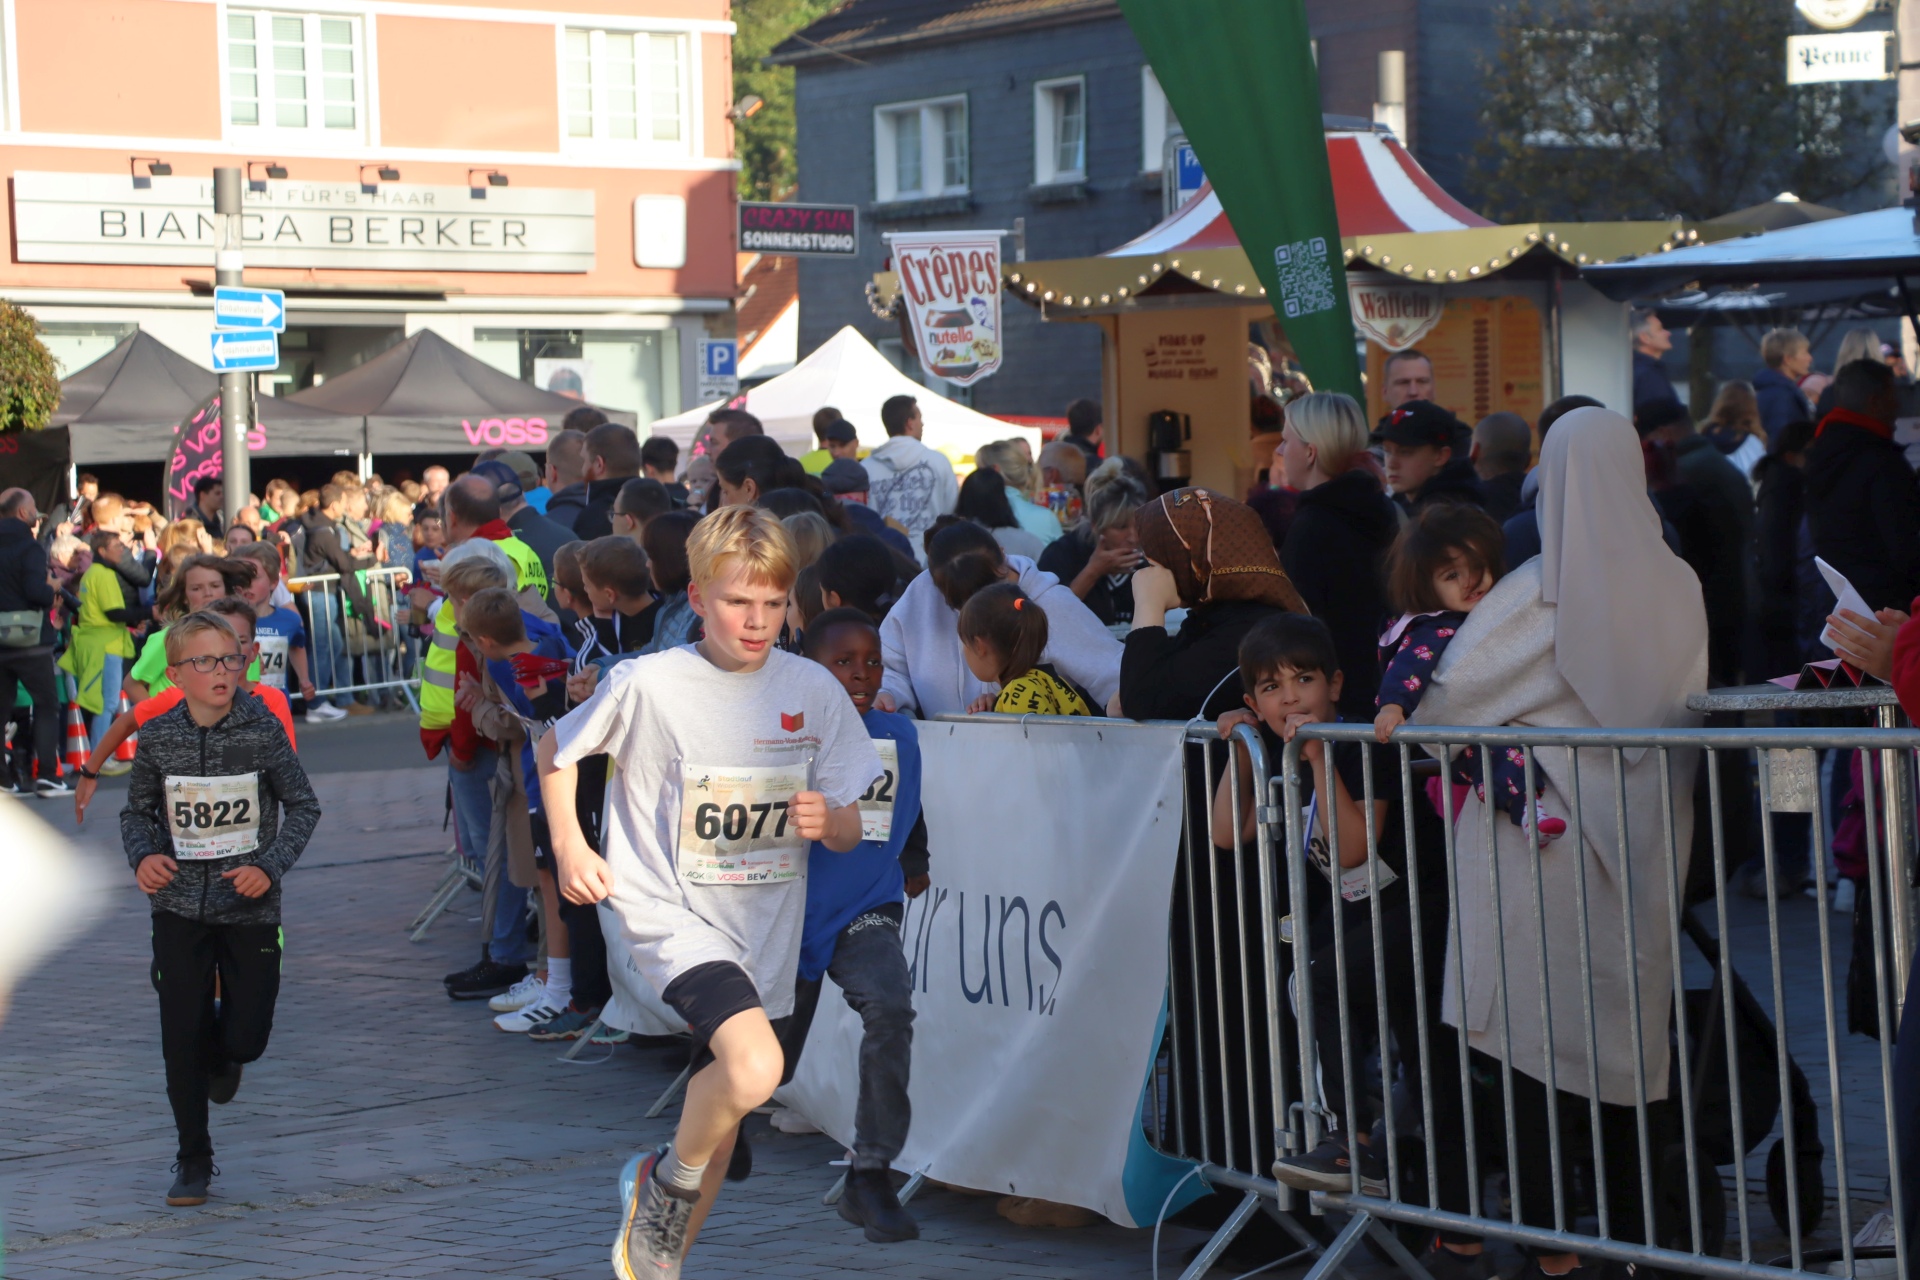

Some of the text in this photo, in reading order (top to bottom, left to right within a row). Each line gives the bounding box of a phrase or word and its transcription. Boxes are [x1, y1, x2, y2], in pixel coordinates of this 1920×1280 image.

[1798, 46, 1872, 69] Penne
[287, 184, 356, 204] FÜR'S
[371, 187, 435, 206] HAAR
[100, 209, 527, 248] BIANCA BERKER
[743, 207, 853, 231] CRAZY SUN
[742, 230, 854, 252] SONNENSTUDIO
[900, 244, 998, 306] Crêpes
[1359, 291, 1431, 319] Waffeln
[929, 326, 973, 345] nutella
[713, 346, 729, 372] P
[461, 417, 549, 446] VOSS
[255, 626, 279, 636] ANGELA
[260, 652, 283, 669] 74
[1010, 683, 1027, 706] YOU
[175, 798, 251, 829] 5822
[694, 801, 790, 841] 6077
[216, 847, 232, 856] BEW
[686, 871, 705, 879] AOK
[717, 873, 745, 881] VOSS
[747, 870, 768, 881] BEW
